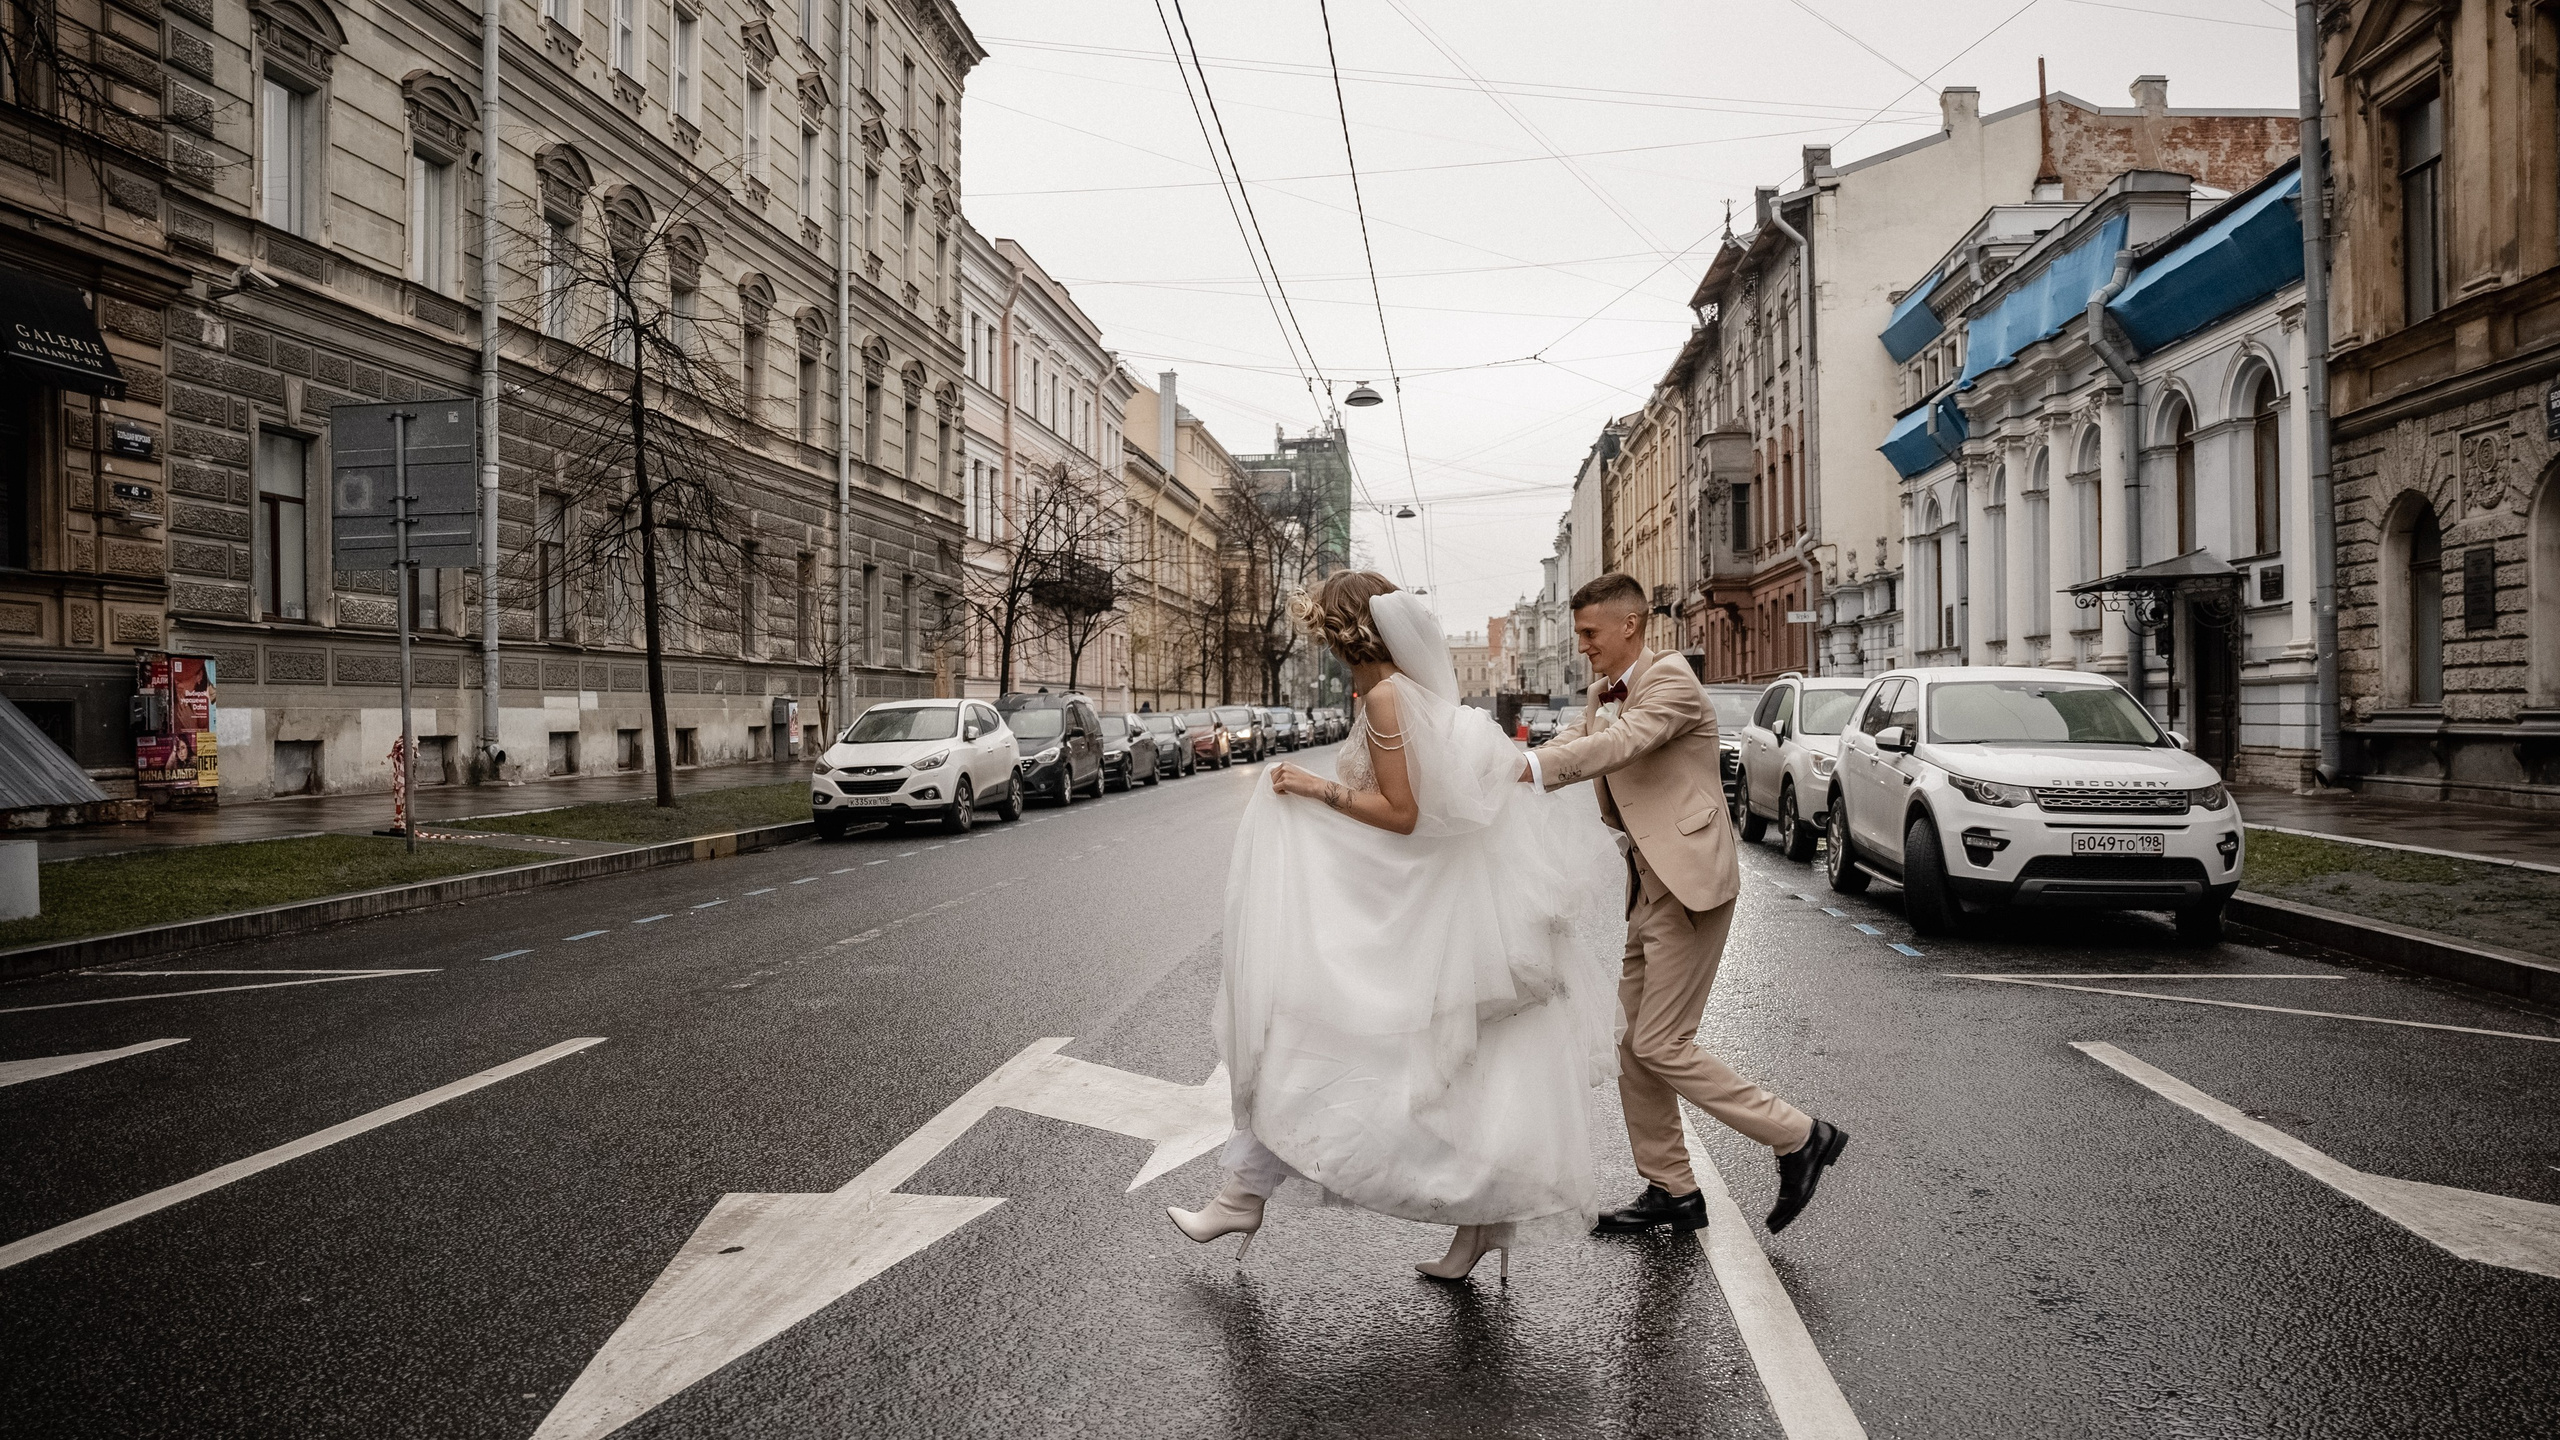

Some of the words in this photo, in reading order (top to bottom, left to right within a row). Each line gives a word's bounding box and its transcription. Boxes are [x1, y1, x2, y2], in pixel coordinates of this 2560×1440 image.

[15, 323, 104, 357] GALERIE
[17, 340, 103, 368] QUARANTE-SIX
[130, 485, 140, 497] 46
[138, 769, 164, 782] ИННА
[2138, 836, 2160, 847] 198
